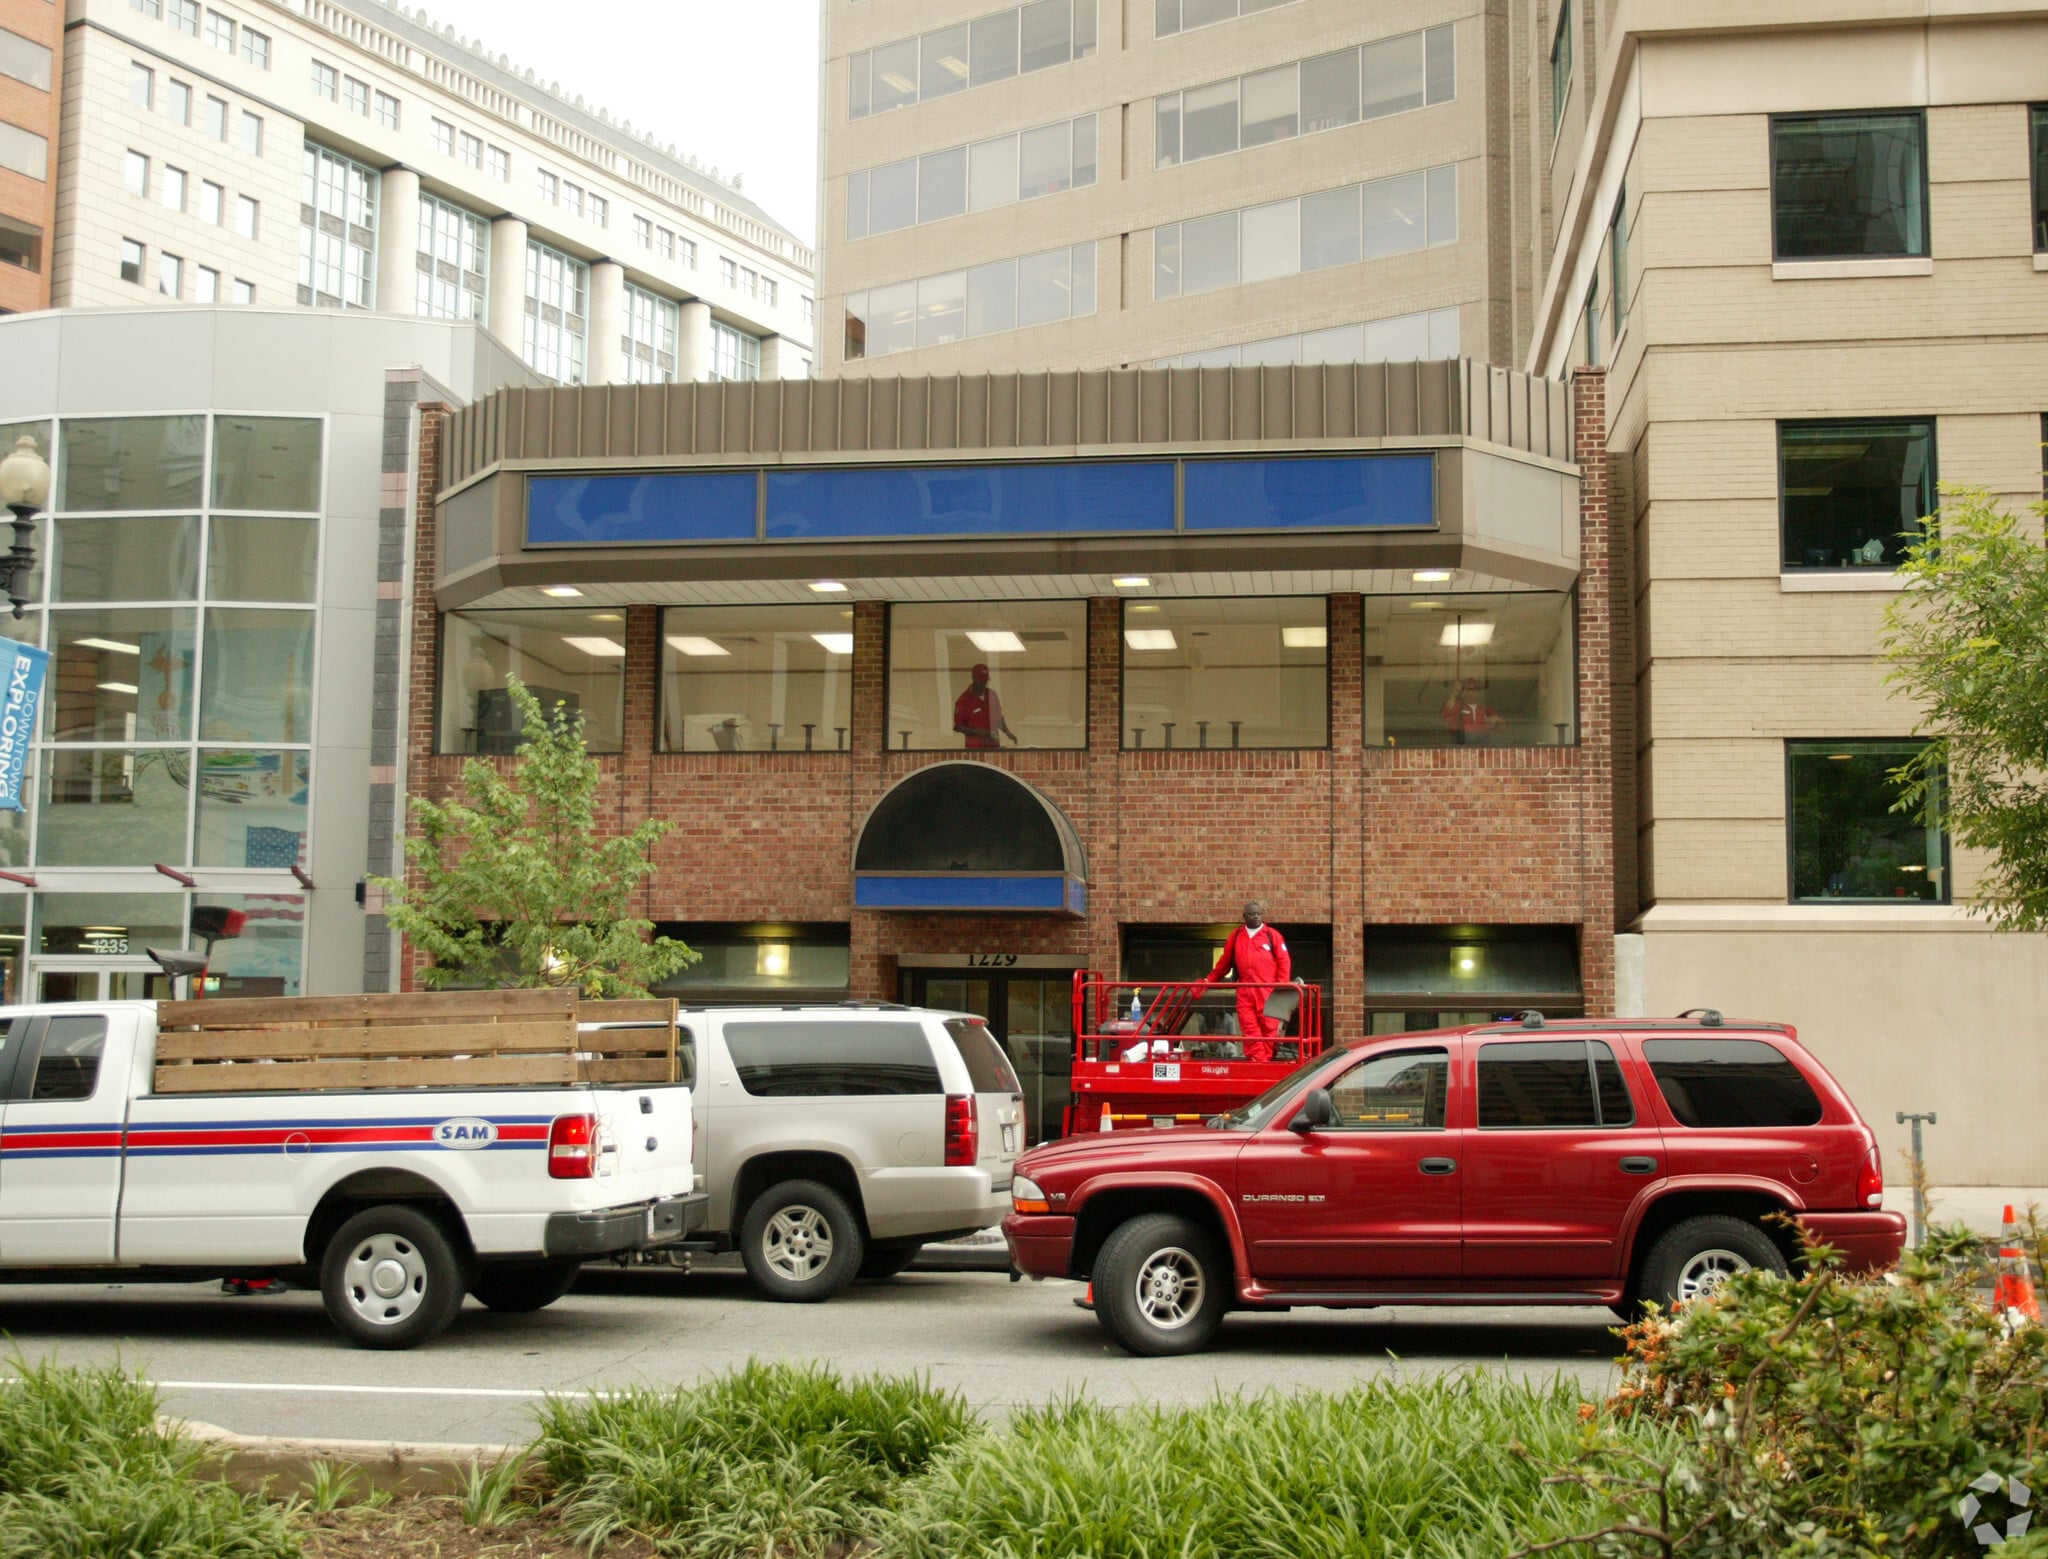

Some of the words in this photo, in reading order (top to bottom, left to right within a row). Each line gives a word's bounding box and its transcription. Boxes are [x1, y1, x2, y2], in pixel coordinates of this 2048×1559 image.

[0, 655, 32, 799] EXPLORING
[9, 690, 37, 800] DOWNTOWN
[92, 938, 128, 954] 1235
[441, 1125, 489, 1140] SAM
[1242, 1194, 1305, 1202] DURANGO
